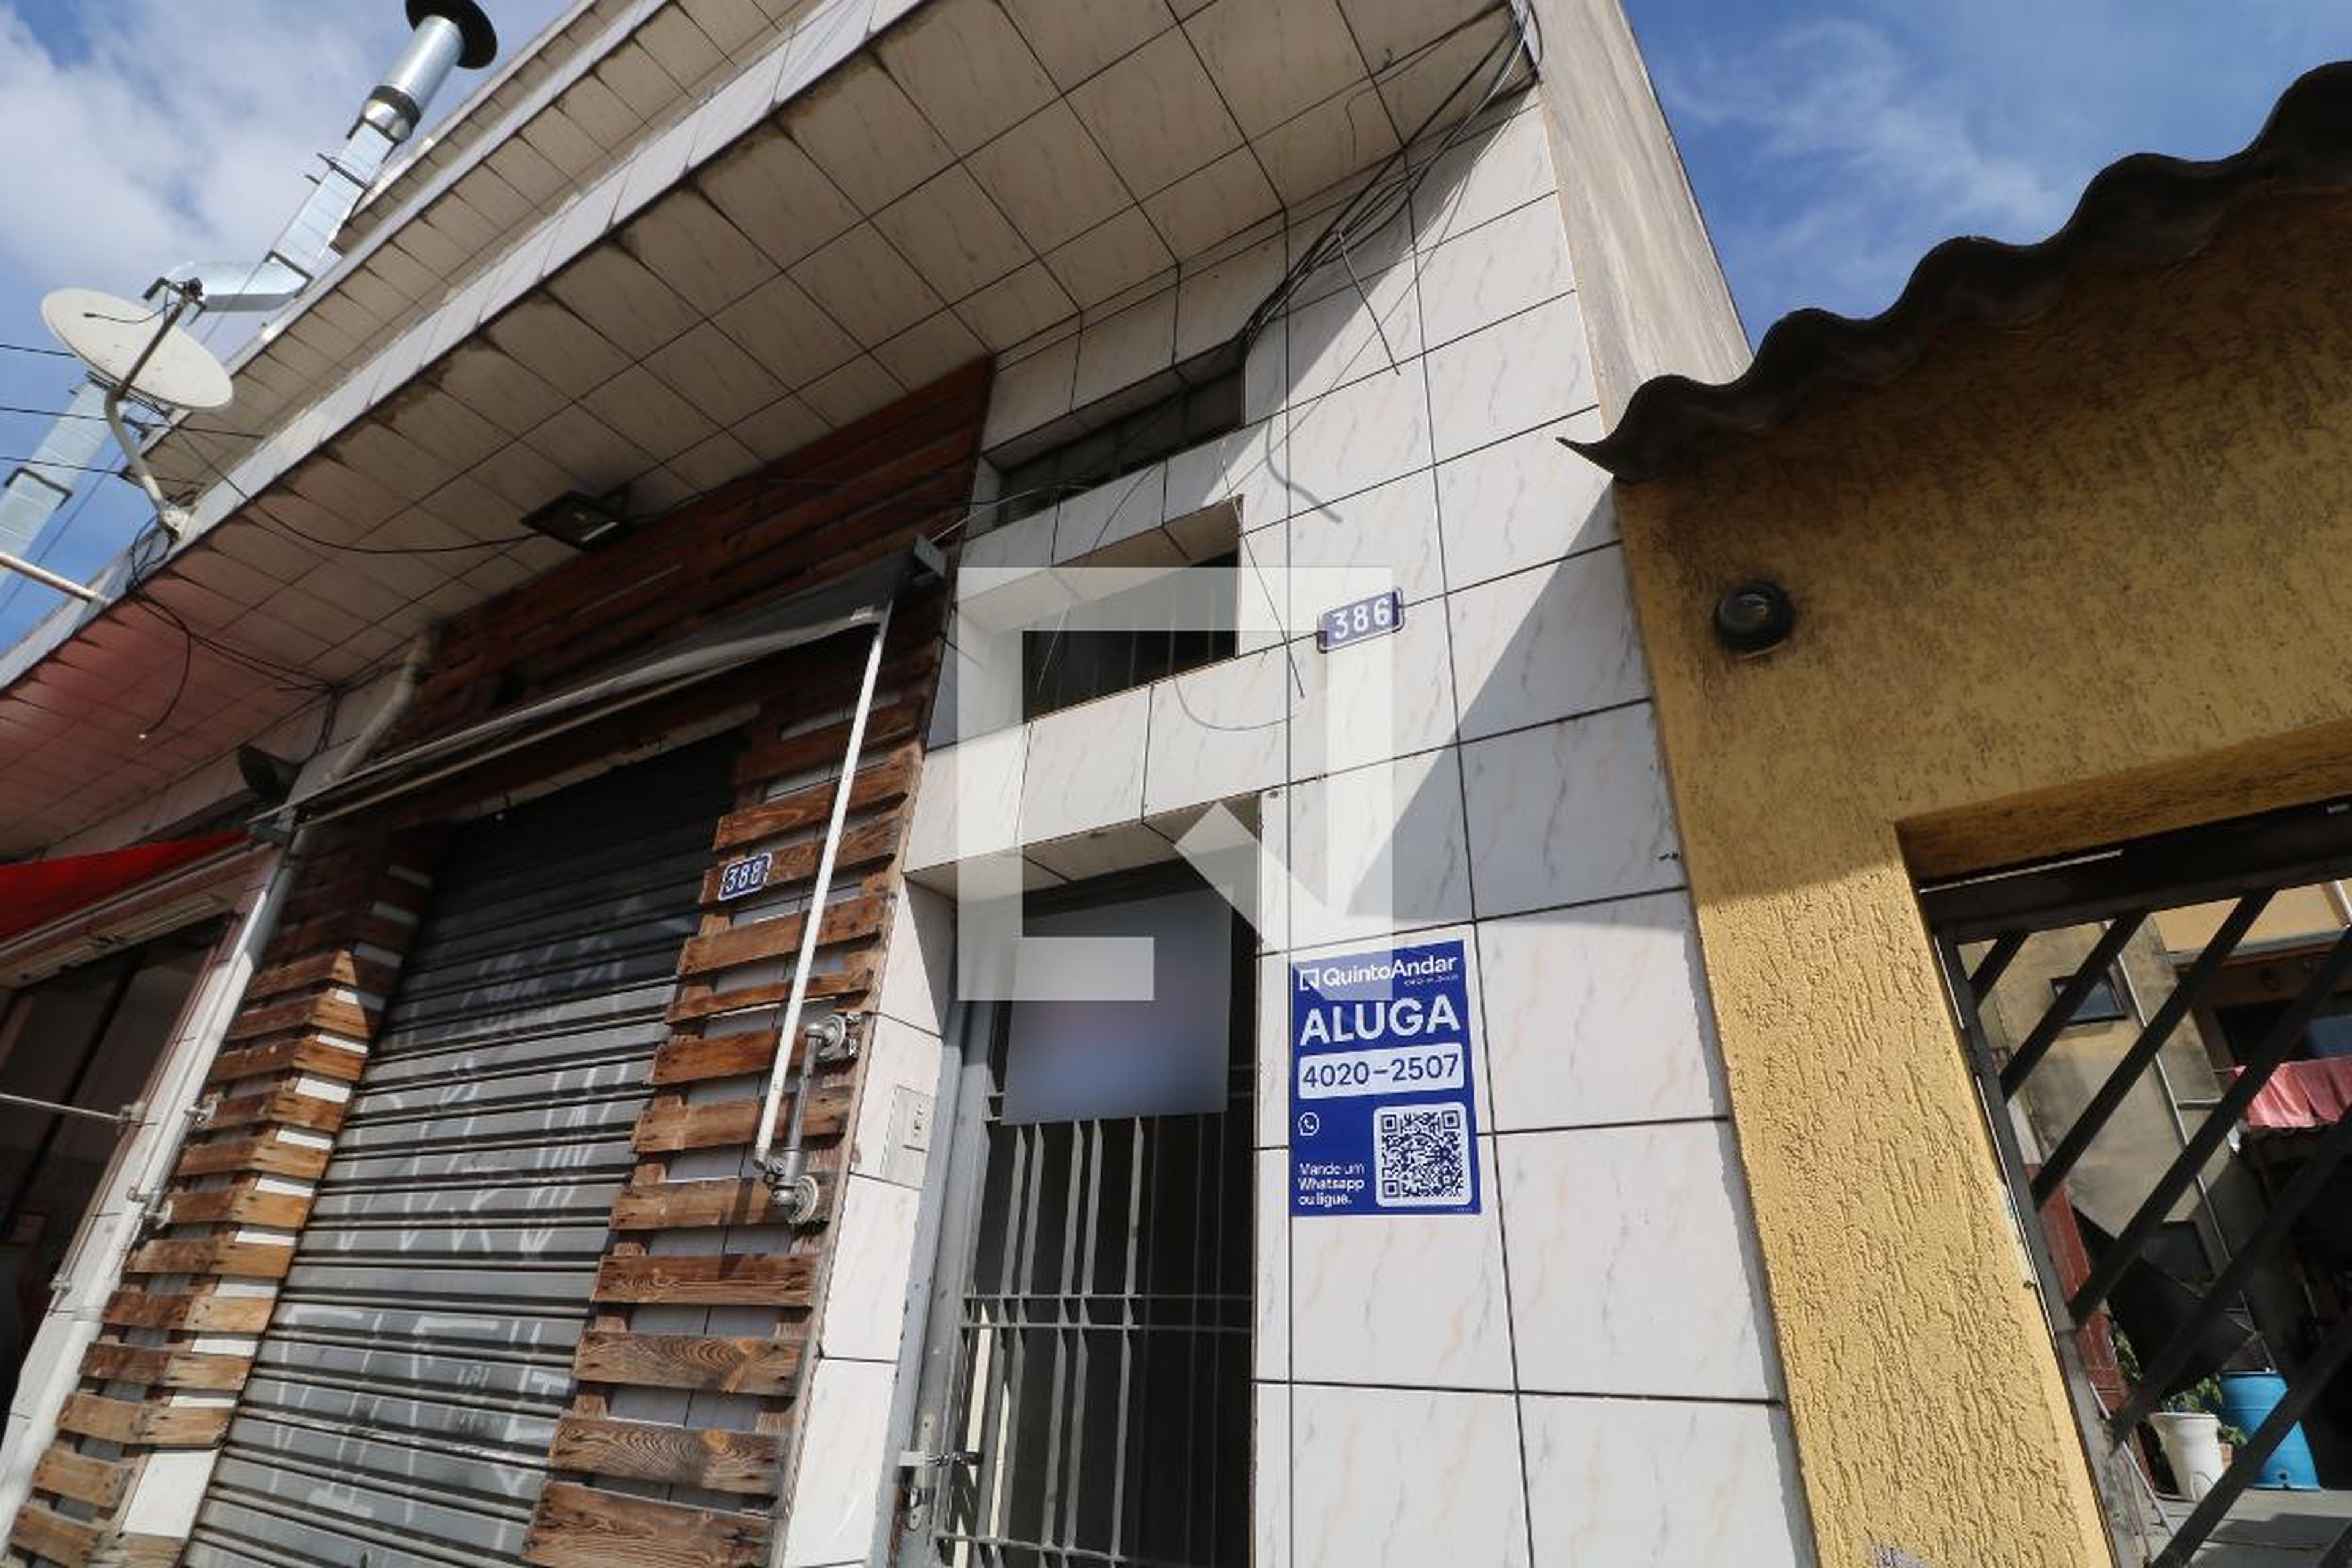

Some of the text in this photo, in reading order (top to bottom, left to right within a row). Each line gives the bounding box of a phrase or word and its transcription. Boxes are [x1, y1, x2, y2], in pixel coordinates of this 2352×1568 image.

[1333, 597, 1390, 639] 386
[1323, 955, 1457, 987] QuintoAndar
[1300, 994, 1460, 1046] ALUGA
[1303, 1054, 1458, 1088] 4020-2507
